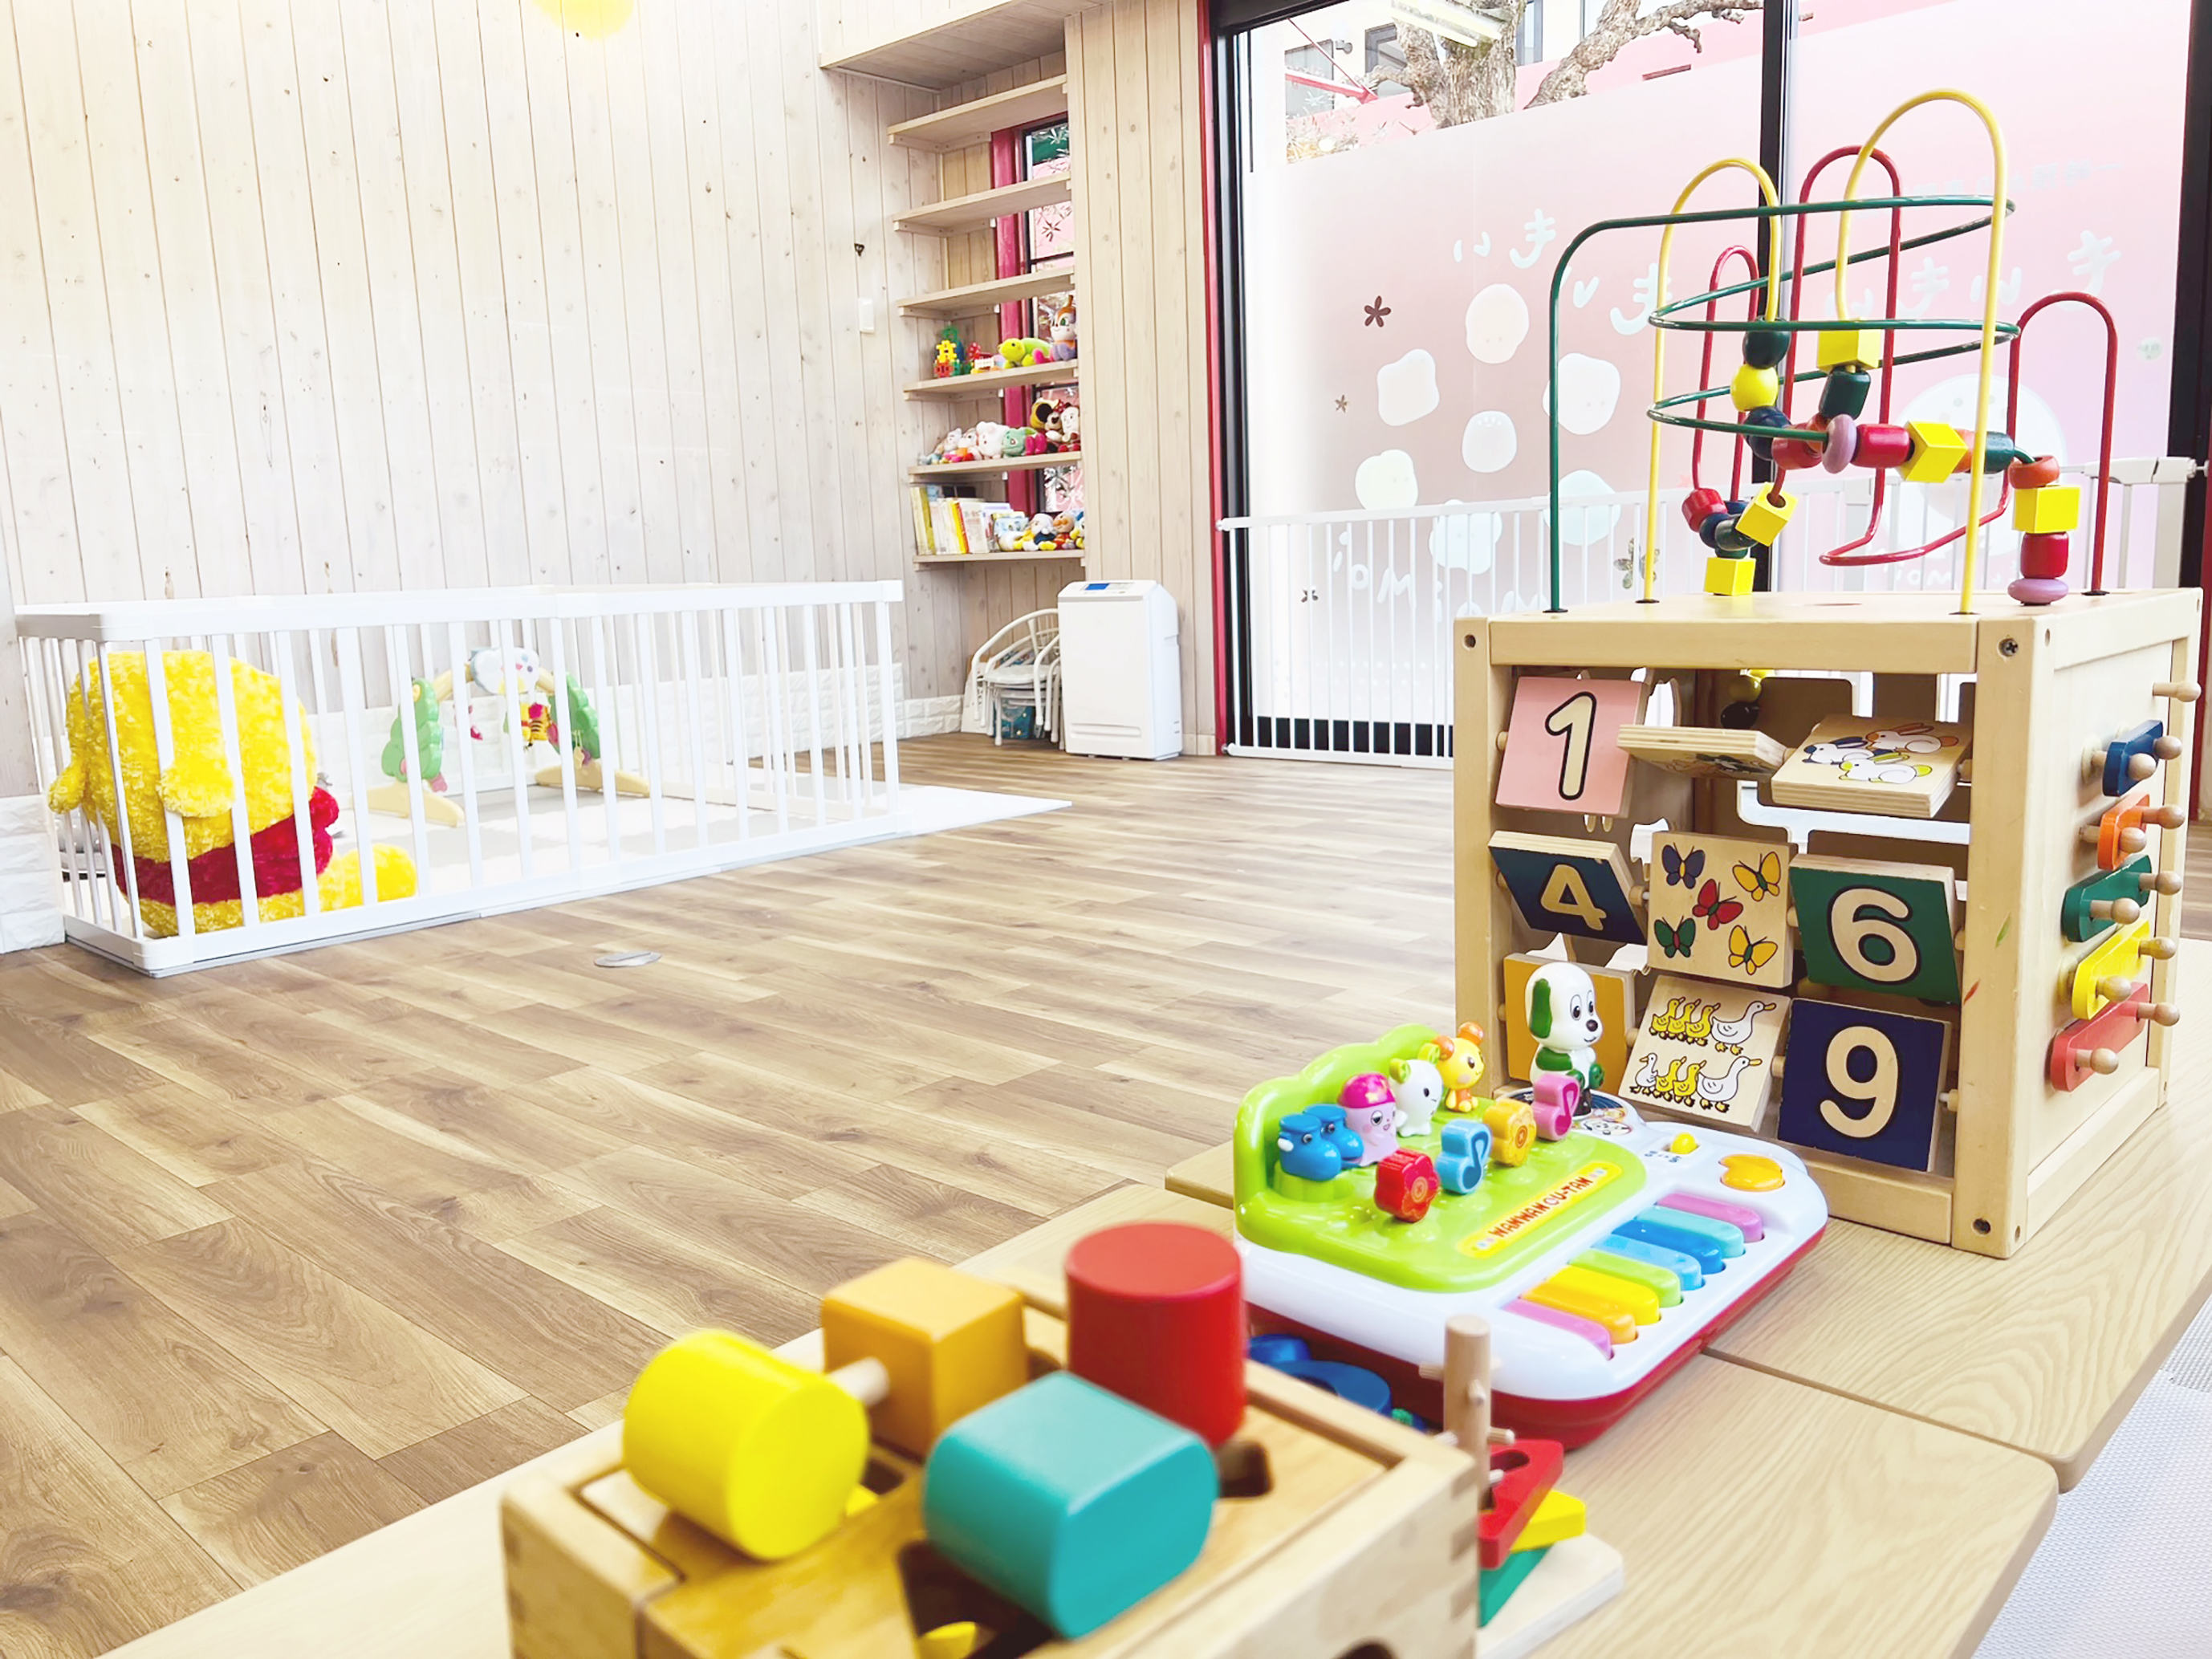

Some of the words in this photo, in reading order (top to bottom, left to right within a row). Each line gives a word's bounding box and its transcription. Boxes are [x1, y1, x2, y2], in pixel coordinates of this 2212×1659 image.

[1545, 691, 1597, 801] 1
[1539, 864, 1607, 931] 4
[1827, 884, 1921, 986] 6
[1819, 1025, 1899, 1138] 9
